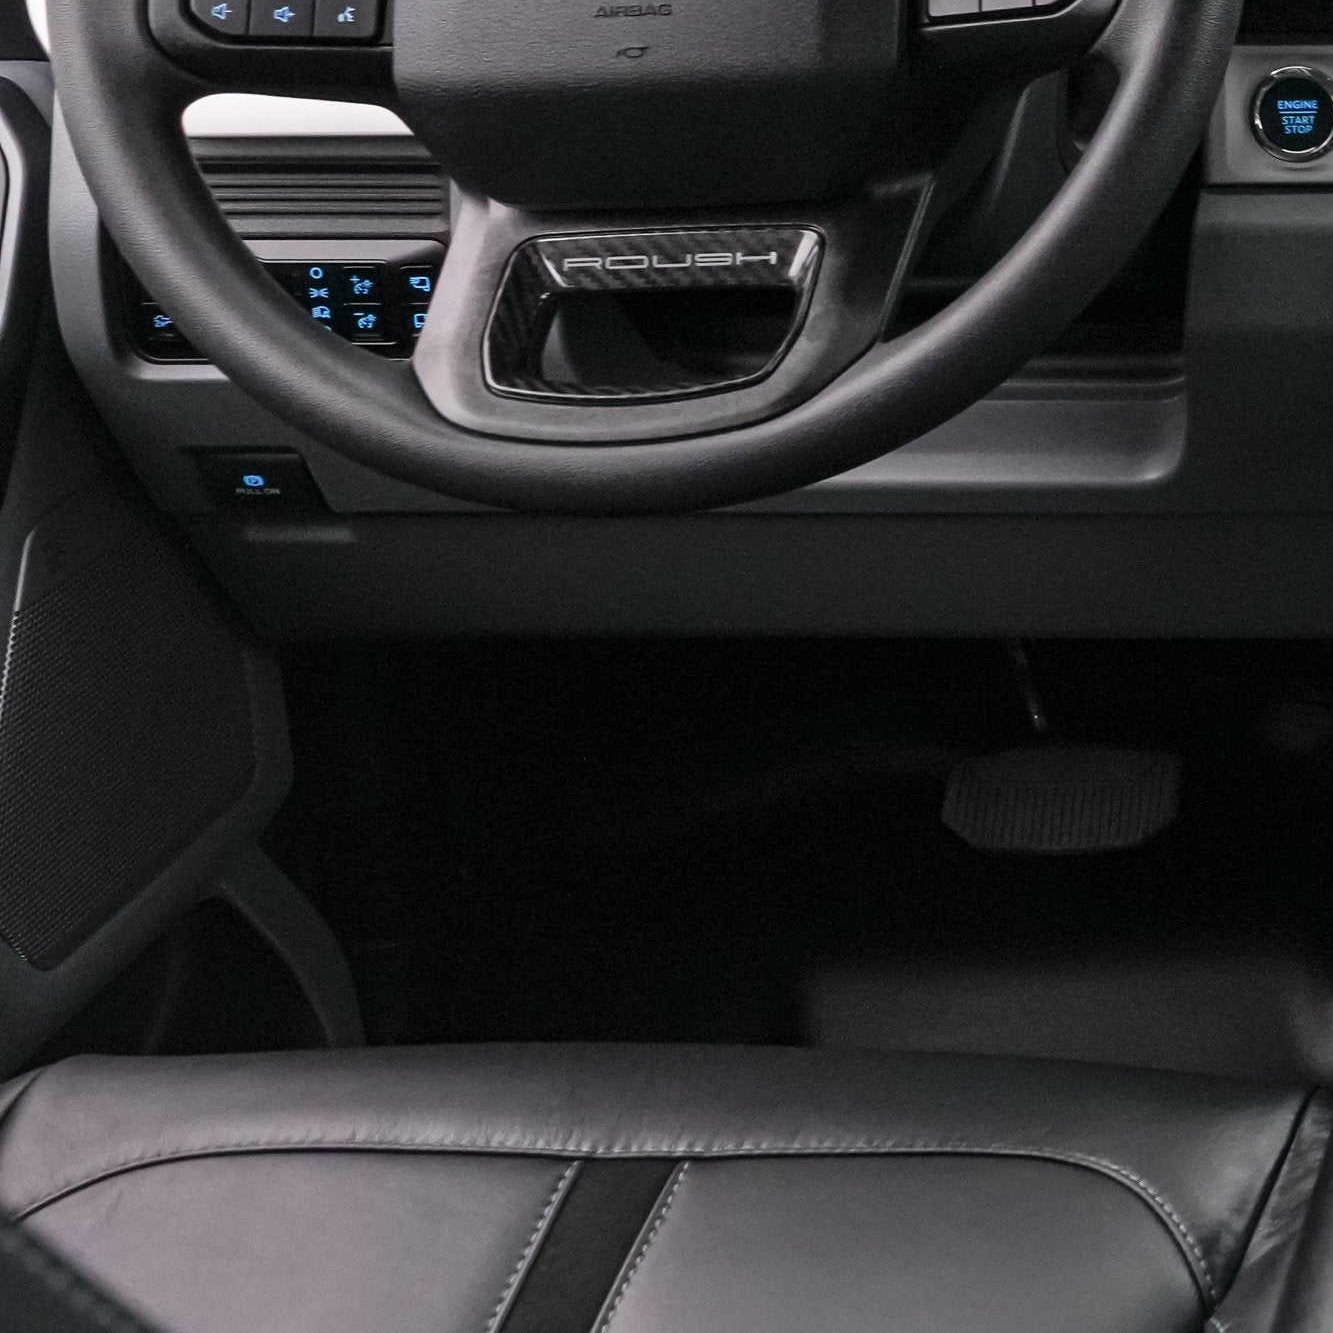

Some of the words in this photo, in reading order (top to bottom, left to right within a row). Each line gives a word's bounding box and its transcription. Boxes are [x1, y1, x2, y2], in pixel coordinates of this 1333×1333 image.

[594, 4, 673, 18] AIRBAG
[1276, 100, 1319, 109] ENGINE
[1281, 115, 1316, 125] START
[1284, 125, 1313, 134] STOP
[562, 251, 778, 272] ROUSH
